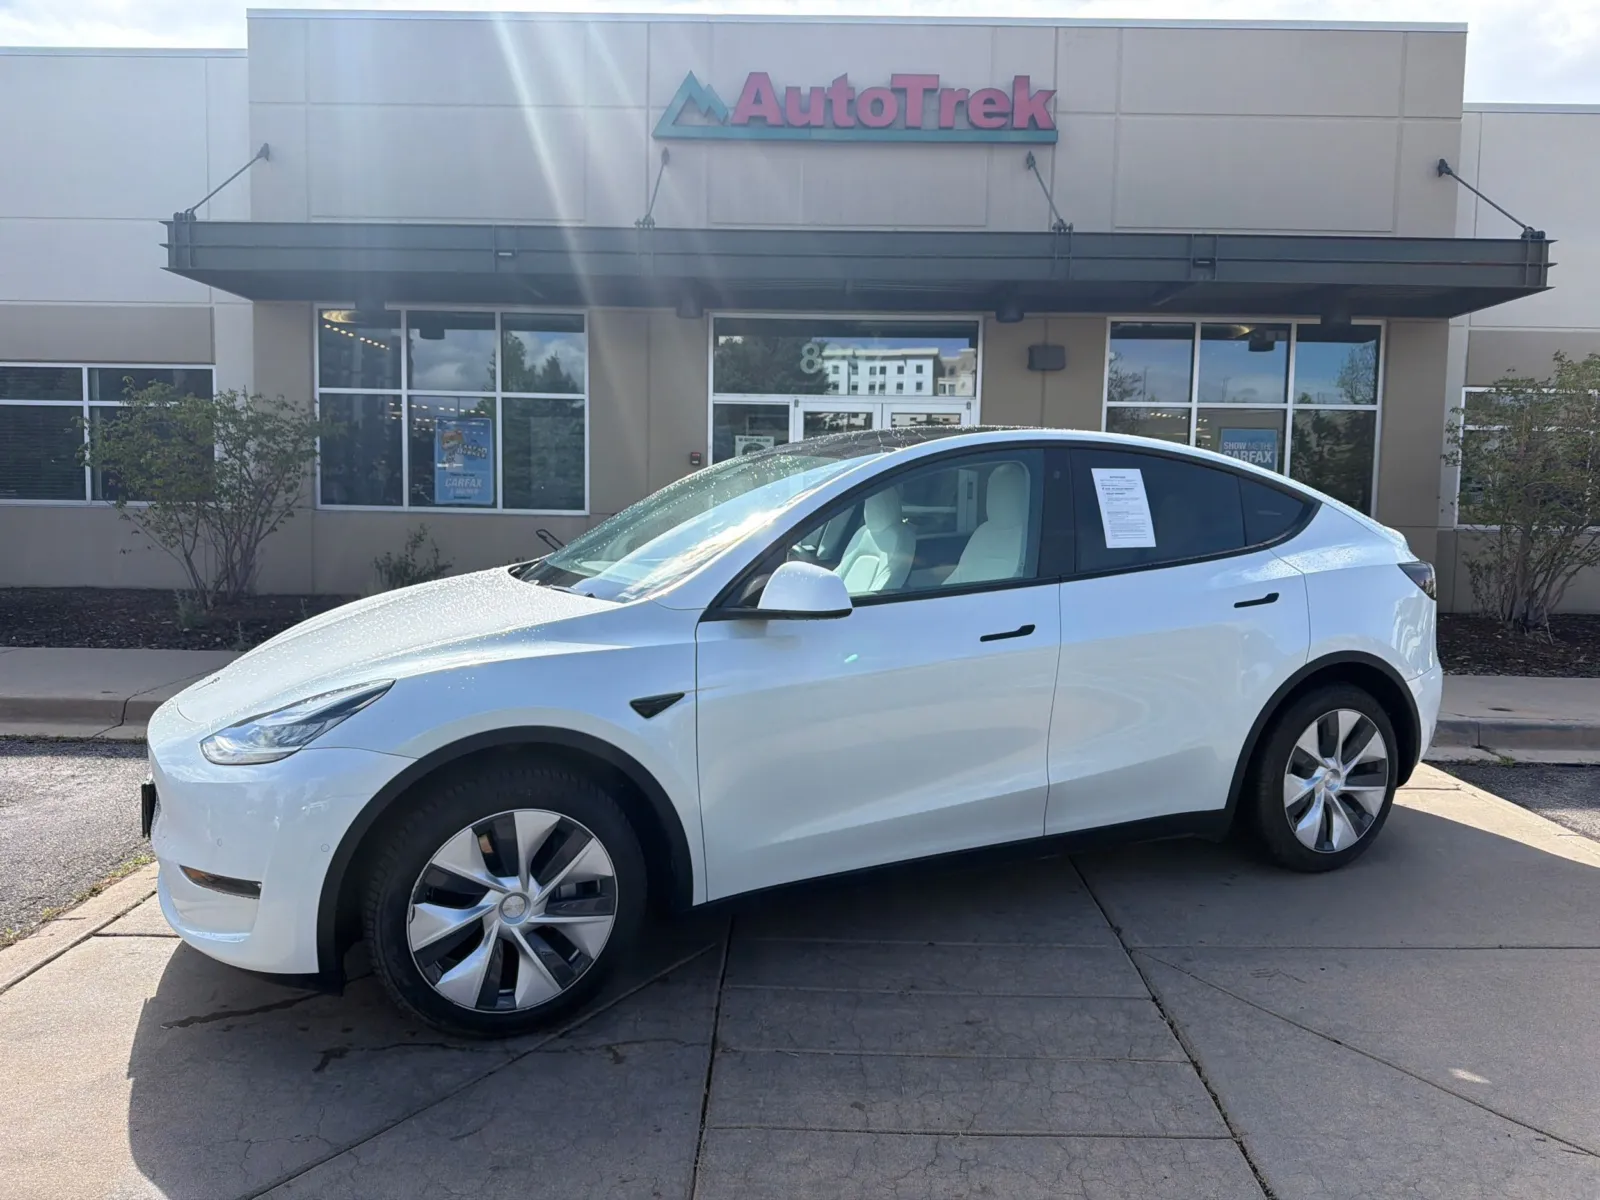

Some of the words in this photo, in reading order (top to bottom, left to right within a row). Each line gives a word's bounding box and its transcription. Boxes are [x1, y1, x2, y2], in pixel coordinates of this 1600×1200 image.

[730, 71, 1057, 130] AutoTrek
[1224, 442, 1246, 450] SHOW
[445, 478, 482, 488] CARFAX
